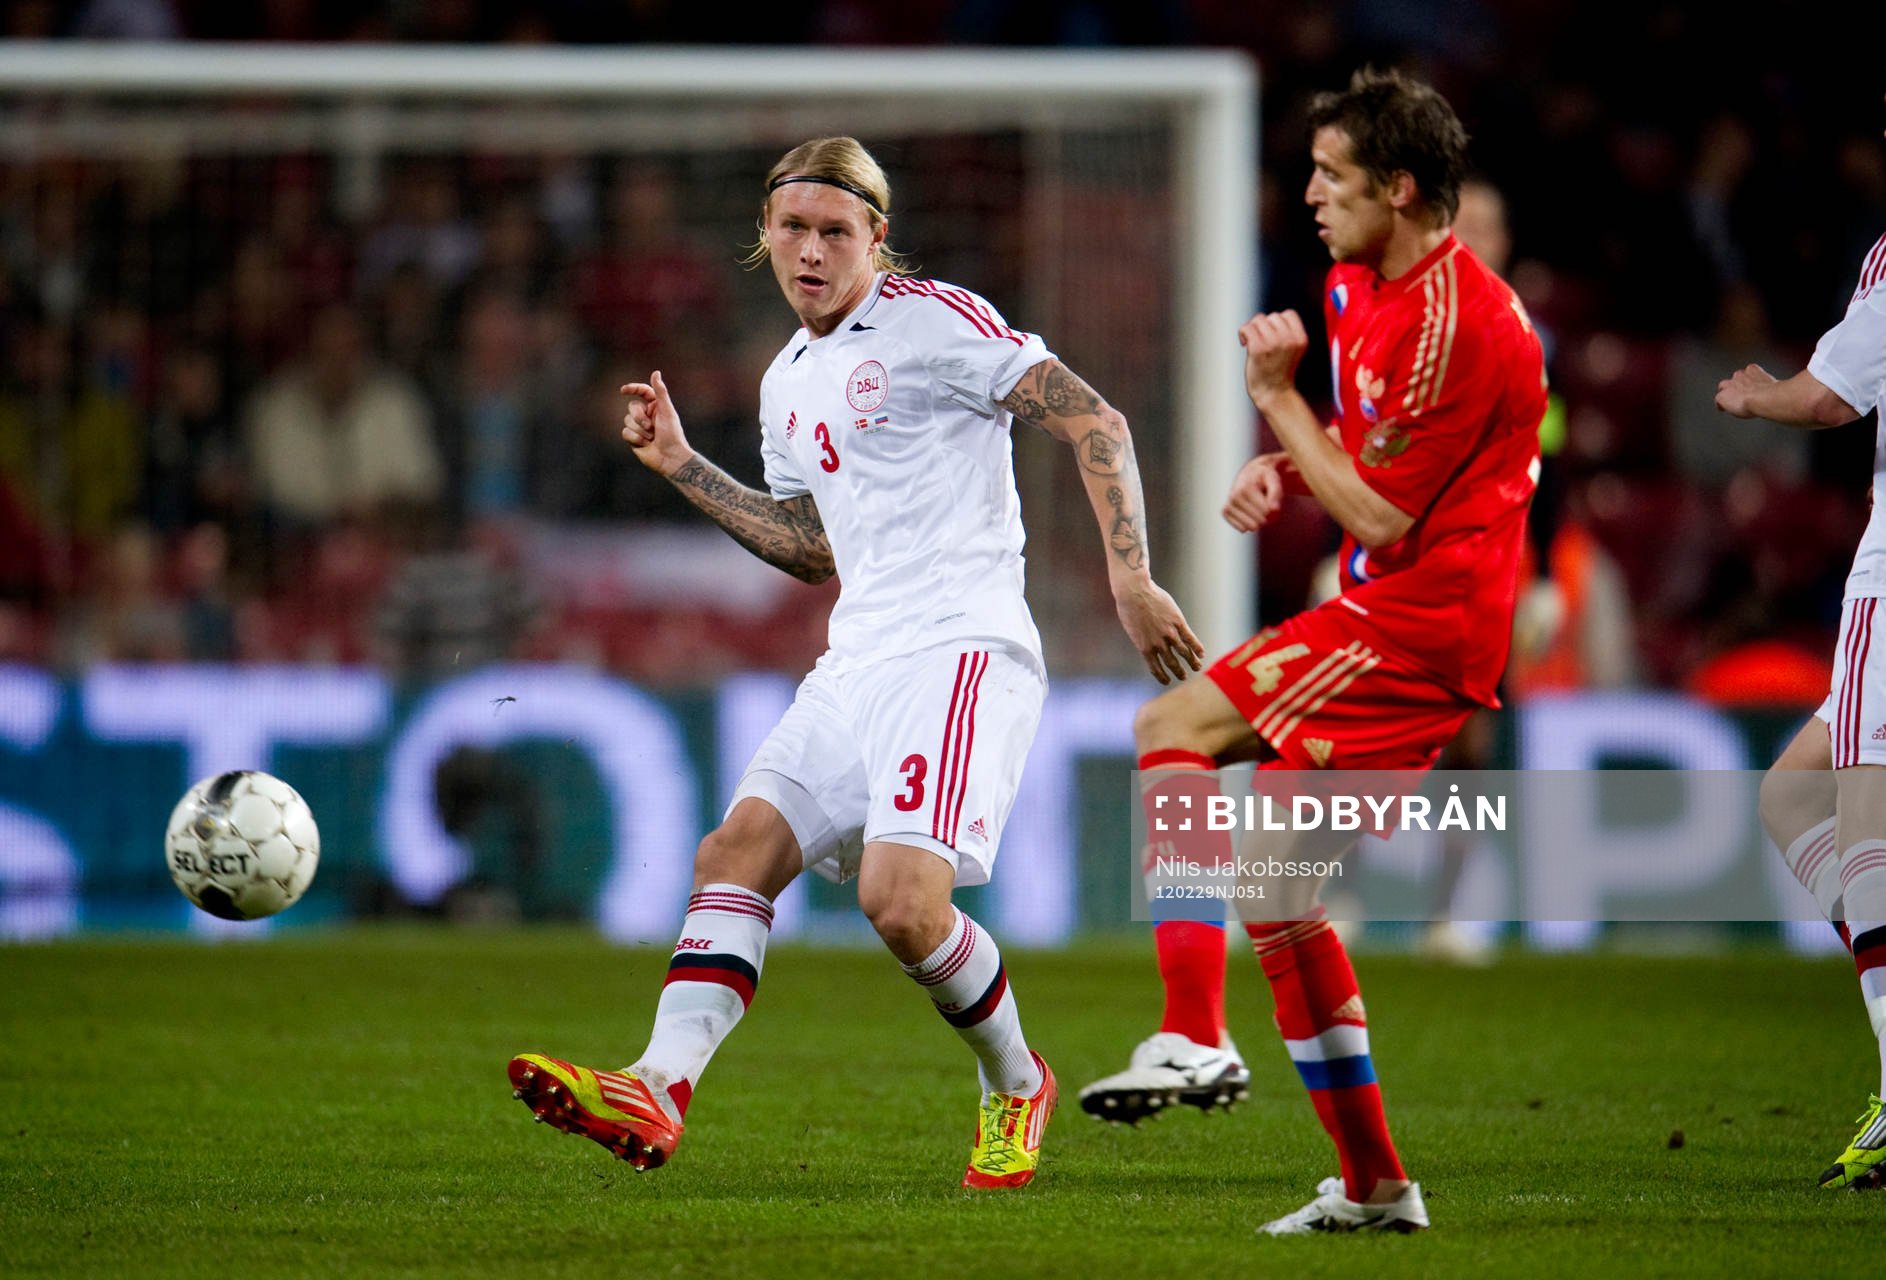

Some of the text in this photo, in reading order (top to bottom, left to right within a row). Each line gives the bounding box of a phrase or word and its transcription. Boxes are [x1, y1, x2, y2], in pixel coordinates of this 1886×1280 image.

[857, 377, 880, 394] DBU
[814, 422, 840, 473] 3
[1227, 629, 1311, 696] 14
[893, 753, 928, 812] 3
[174, 850, 249, 875] SELECT
